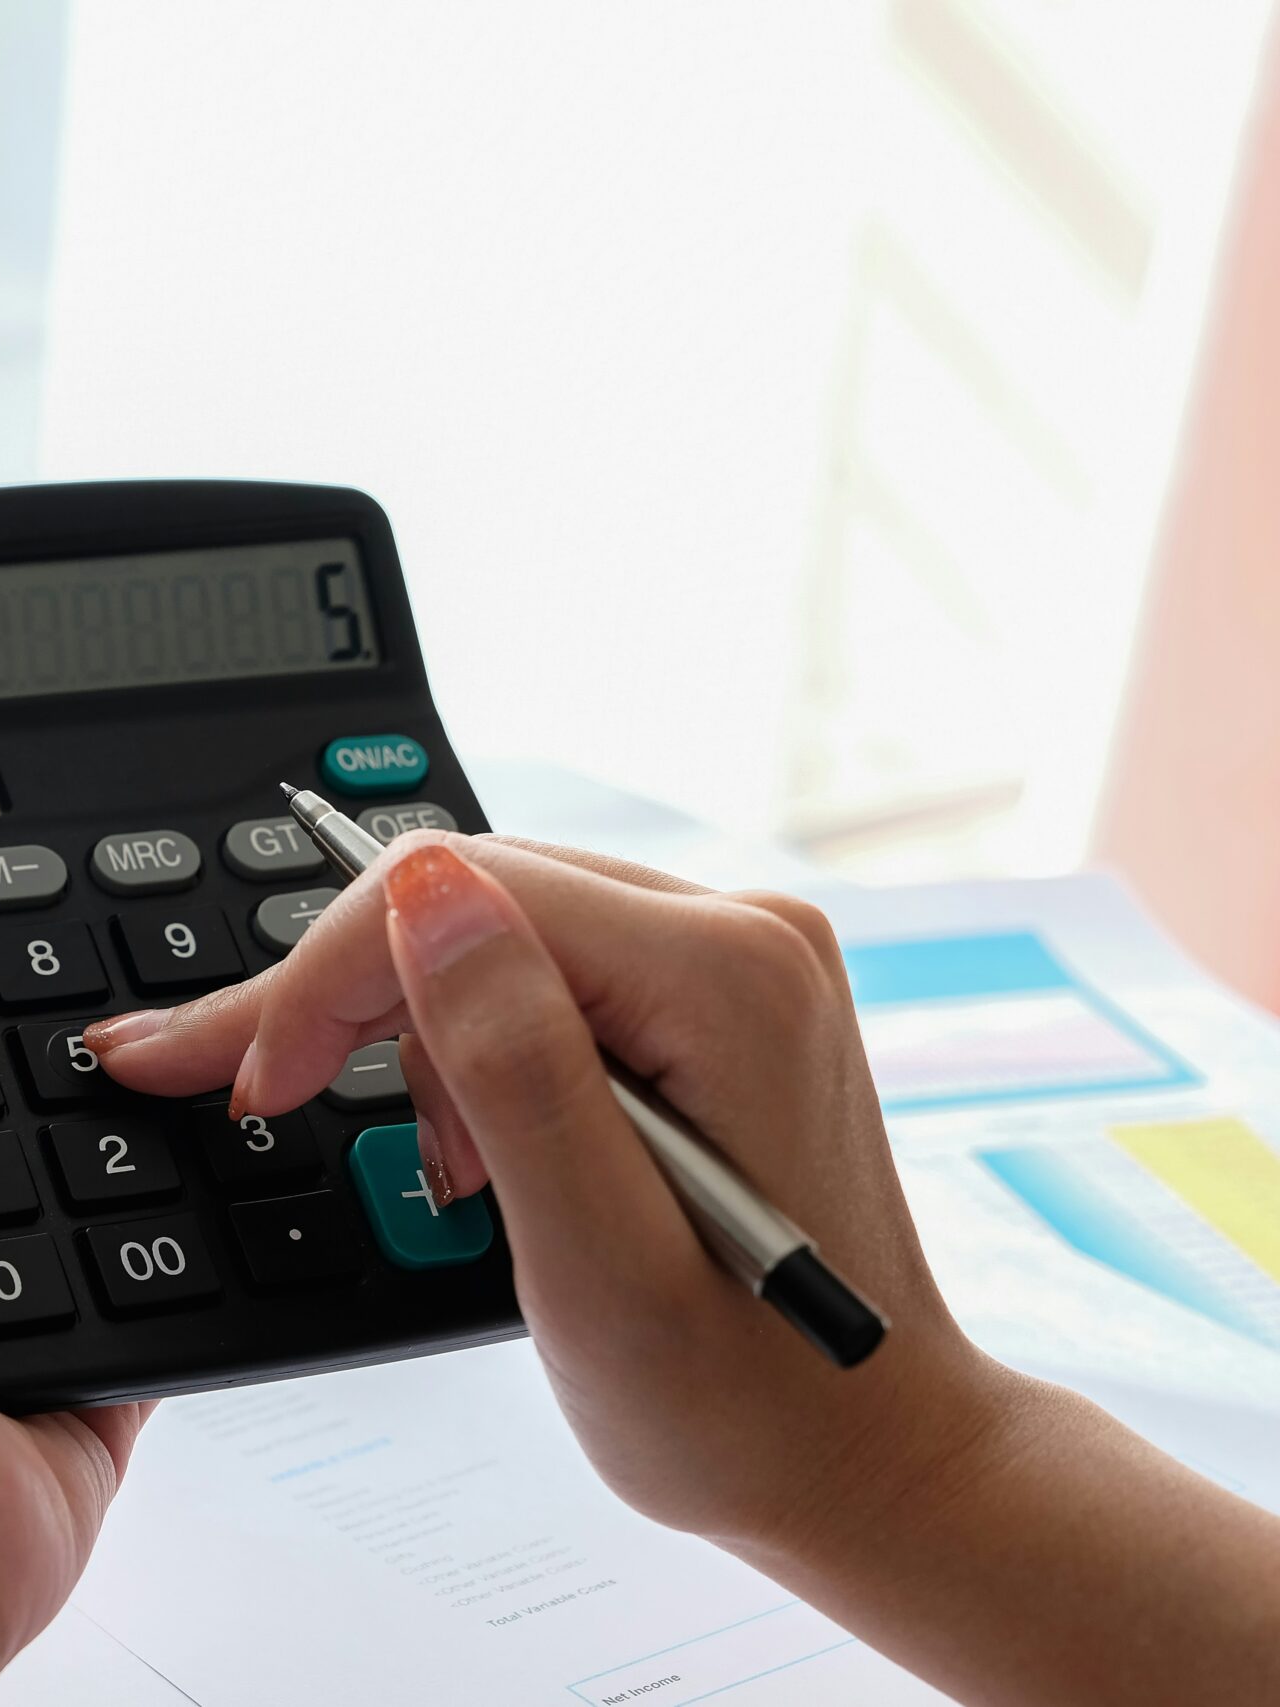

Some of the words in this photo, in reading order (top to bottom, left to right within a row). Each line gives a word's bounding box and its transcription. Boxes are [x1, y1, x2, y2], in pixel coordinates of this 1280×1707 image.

[336, 743, 418, 771] ON/AC
[250, 824, 298, 856] GT
[371, 809, 438, 843] OFF
[105, 838, 182, 872] MRC
[27, 940, 60, 976] 8
[164, 923, 197, 958] 9
[66, 1035, 99, 1072] 5
[240, 1115, 275, 1152] 3
[98, 1135, 136, 1174] 2
[120, 1236, 186, 1281] 00
[486, 1610, 522, 1629] Total
[521, 1594, 577, 1616] Variable
[577, 1577, 618, 1597] Costs
[601, 1692, 631, 1706] Net
[627, 1674, 682, 1698] Income
